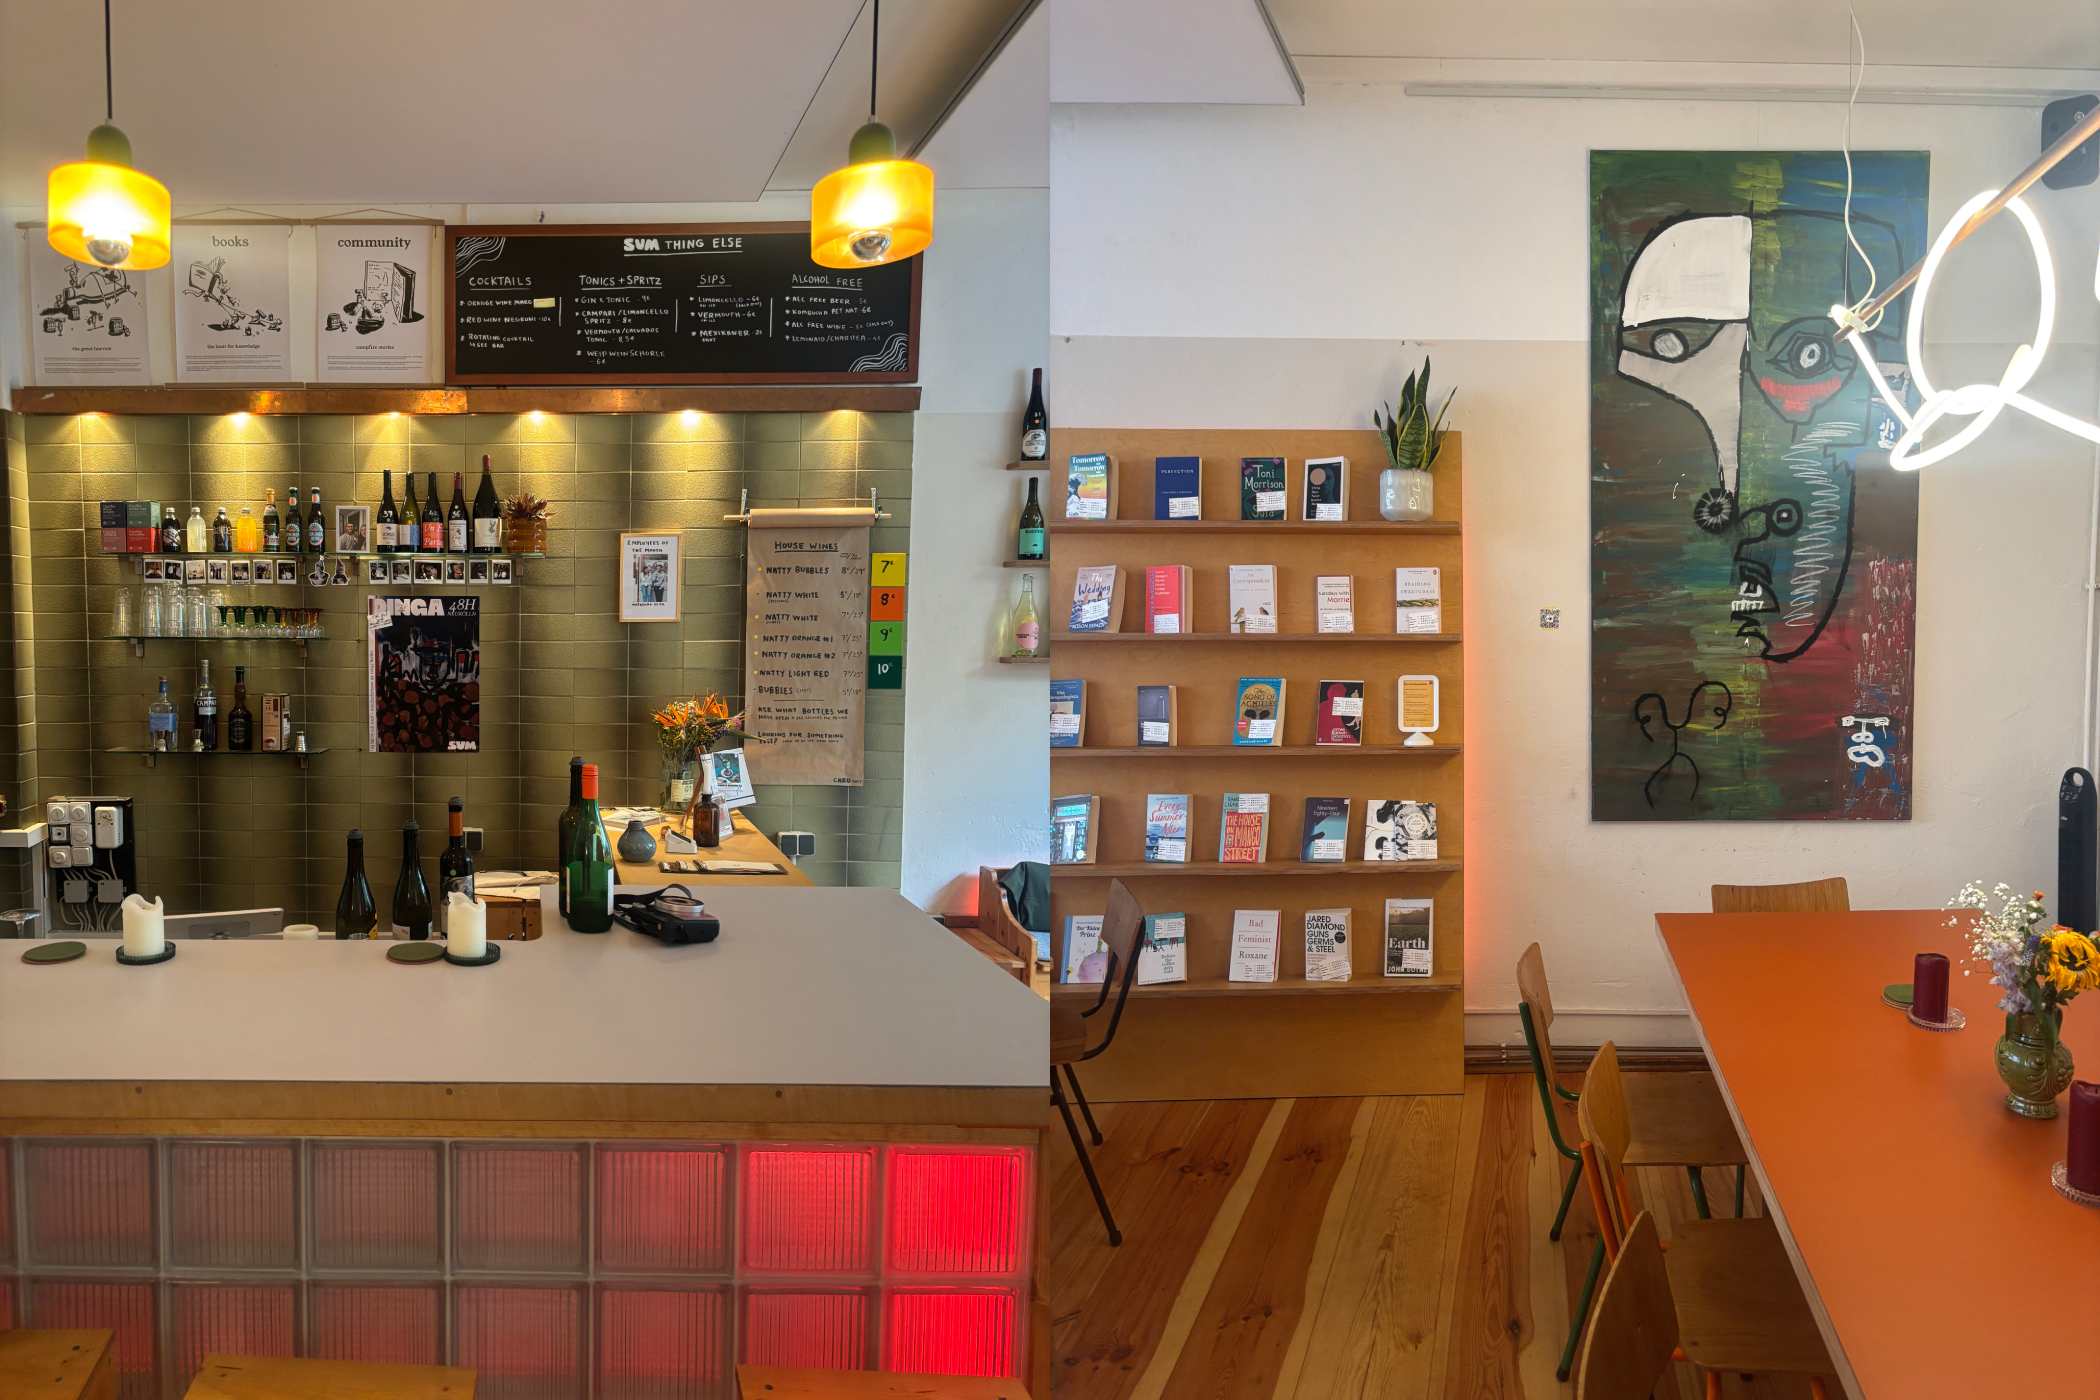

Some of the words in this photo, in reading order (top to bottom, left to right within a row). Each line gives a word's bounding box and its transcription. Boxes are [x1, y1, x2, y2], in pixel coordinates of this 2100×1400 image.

[212, 236, 249, 248] books
[337, 236, 412, 250] community
[665, 238, 704, 251] THING
[712, 236, 742, 248] ELSE
[469, 276, 532, 286] COCKTAILS
[579, 274, 615, 286] TONICS
[626, 275, 662, 286] SPRITZ
[700, 274, 726, 285] SIPS
[792, 274, 830, 285] ALCOHOL
[836, 277, 863, 288] FREE
[1071, 455, 1106, 465] Tomorrow
[1252, 464, 1275, 478] Toni
[1244, 477, 1284, 492] Morrison
[774, 541, 804, 550] HOUSE
[810, 542, 838, 550] WINES
[766, 566, 791, 574] NATTY
[794, 566, 830, 575] BUBBLES
[766, 592, 792, 600] NATTY
[449, 598, 476, 613] 48H
[765, 614, 790, 622] NATTY
[793, 614, 818, 622] WHITE
[762, 634, 789, 643] NATTY
[761, 650, 788, 659] NATTY
[790, 652, 822, 660] ORANGE
[759, 670, 785, 678] NATTY
[788, 670, 811, 678] LIGHT
[813, 670, 830, 678] RED
[1224, 847, 1258, 860] STREET
[1248, 920, 1264, 928] Bad
[1307, 915, 1331, 924] JARED
[1306, 922, 1346, 931] DIAMOND
[1237, 934, 1271, 944] Feminist
[1307, 930, 1330, 938] GUNS
[1307, 937, 1334, 946] GERMS
[1388, 938, 1427, 950] Earth
[1307, 945, 1314, 953] &
[1315, 945, 1336, 953] STEEL
[1239, 950, 1268, 961] Roxane
[1387, 966, 1404, 974] JOHN
